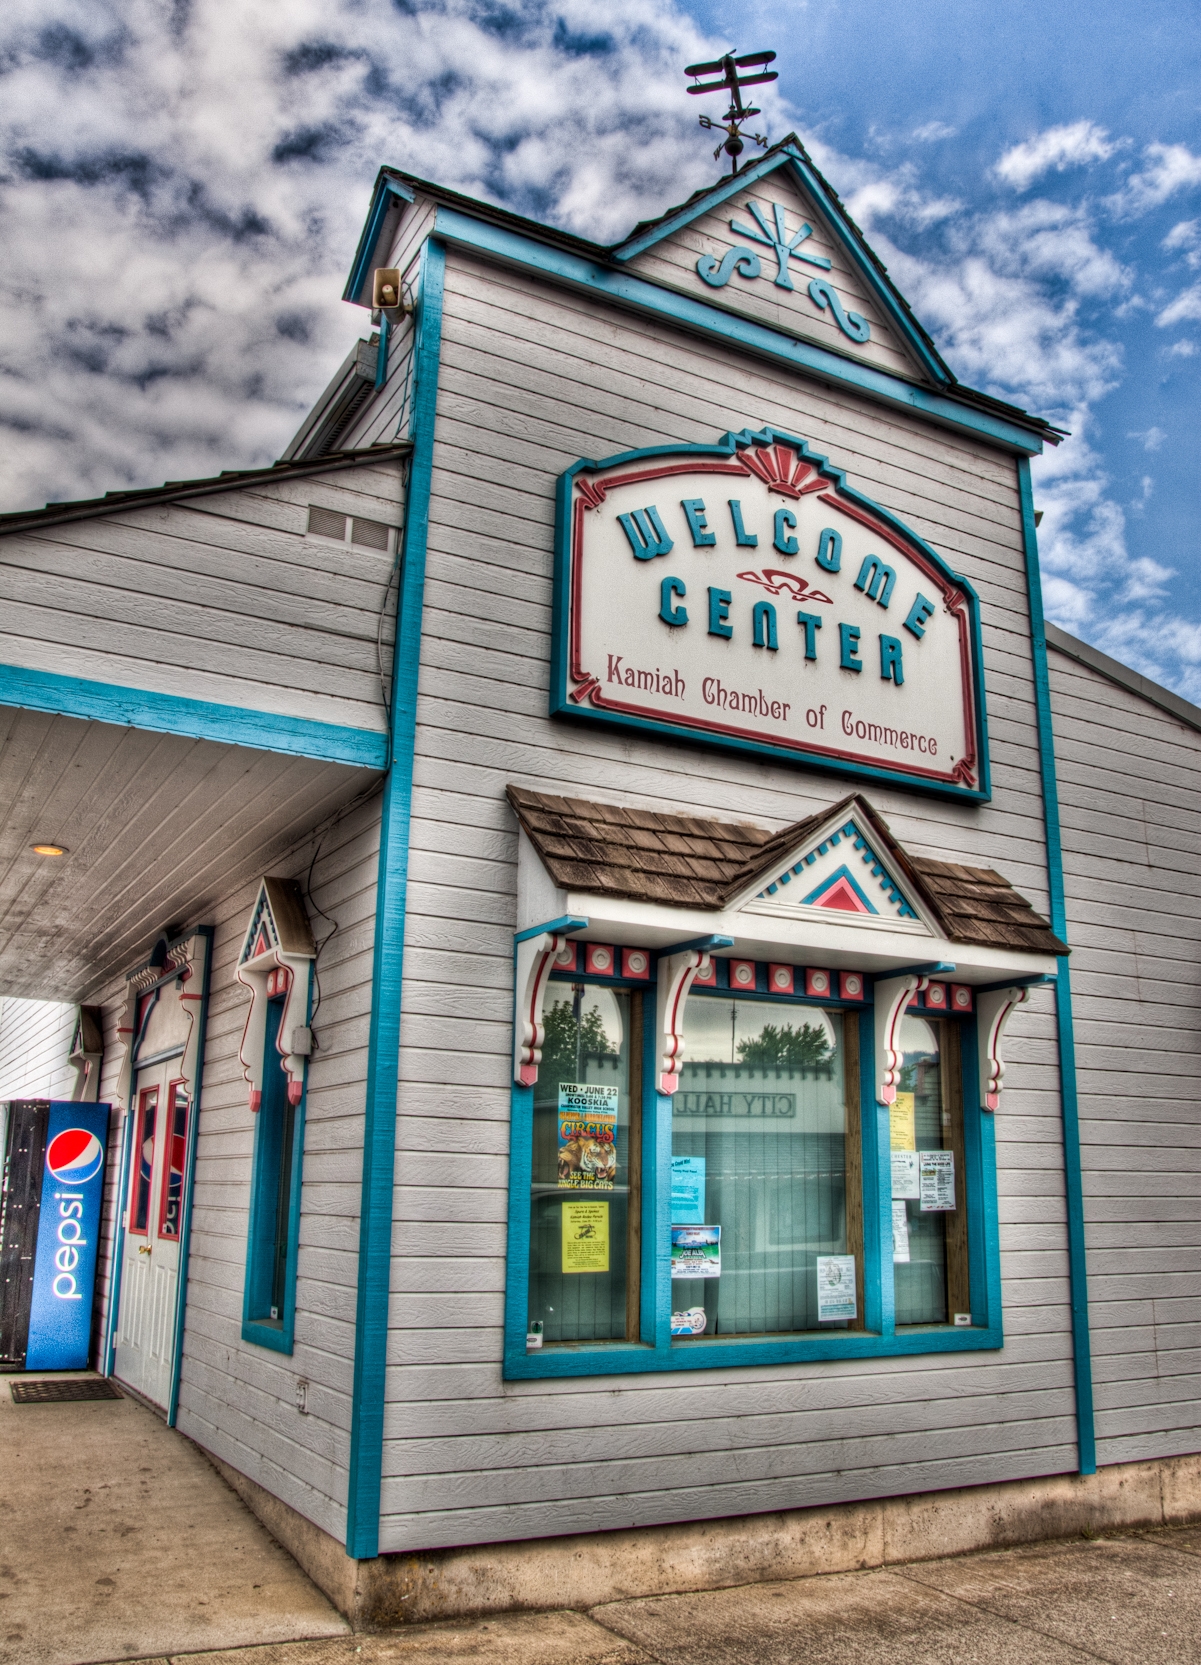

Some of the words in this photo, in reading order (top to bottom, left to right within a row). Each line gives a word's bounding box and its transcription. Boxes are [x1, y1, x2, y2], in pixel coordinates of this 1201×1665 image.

[616, 497, 935, 640] WELCOME
[658, 575, 904, 687] CENTER
[606, 653, 686, 701] Kamiah
[702, 677, 791, 721] Chamber
[806, 704, 828, 730] of
[841, 710, 938, 757] Commerce
[560, 1084, 578, 1093] WED
[585, 1086, 605, 1095] JUNE
[607, 1088, 617, 1096] 22
[568, 1097, 608, 1106] KOOSKIA
[560, 1121, 614, 1144] CIRCUS
[569, 1171, 582, 1180] SEE
[582, 1172, 595, 1180] THE
[580, 1180, 593, 1189] BIG
[594, 1181, 613, 1191] CATS
[53, 1193, 87, 1299] pepsi
